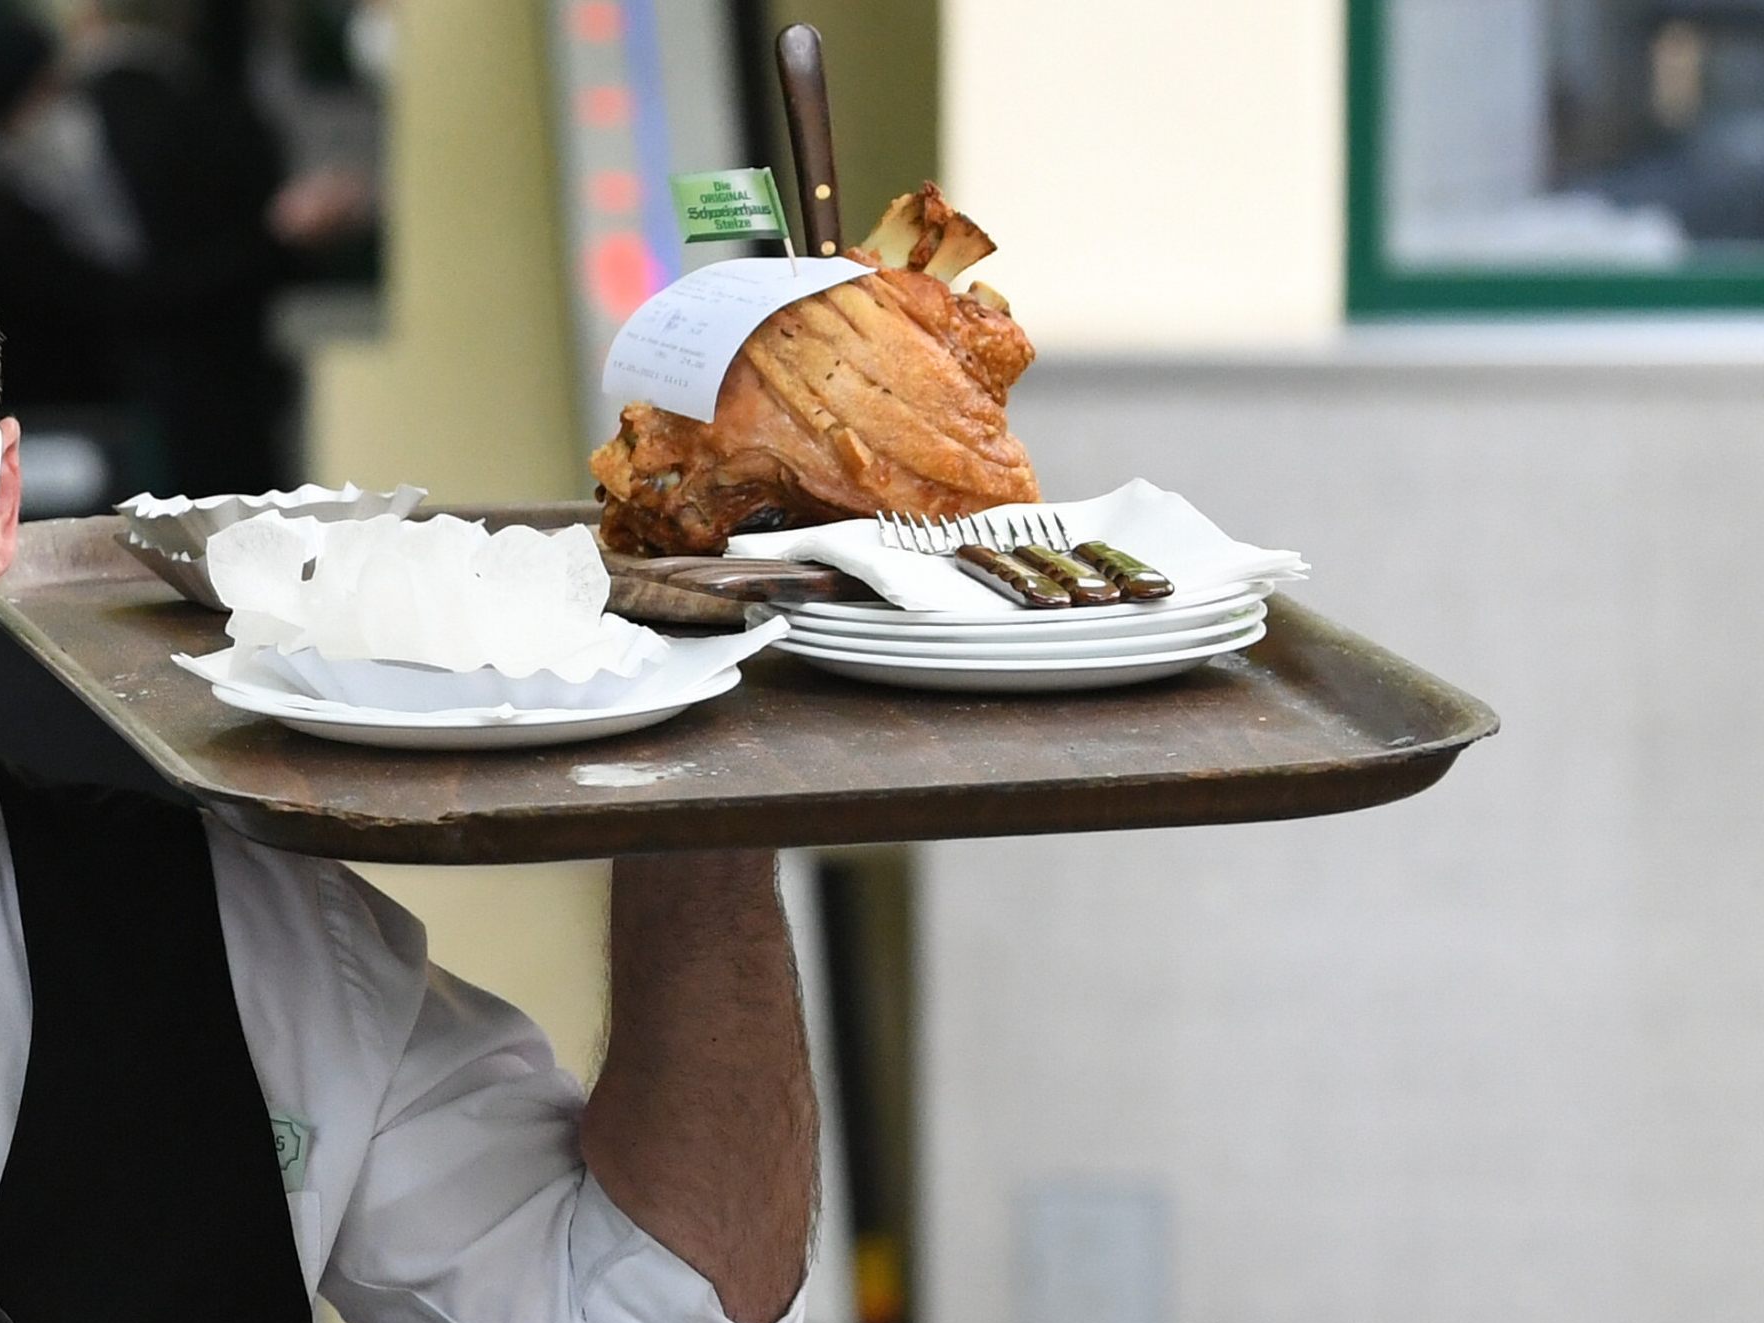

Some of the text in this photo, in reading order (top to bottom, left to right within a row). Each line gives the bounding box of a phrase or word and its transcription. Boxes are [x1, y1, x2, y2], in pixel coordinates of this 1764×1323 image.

[713, 180, 732, 192] Die
[699, 190, 752, 204] ORIGINAL
[714, 218, 752, 231] Stelze
